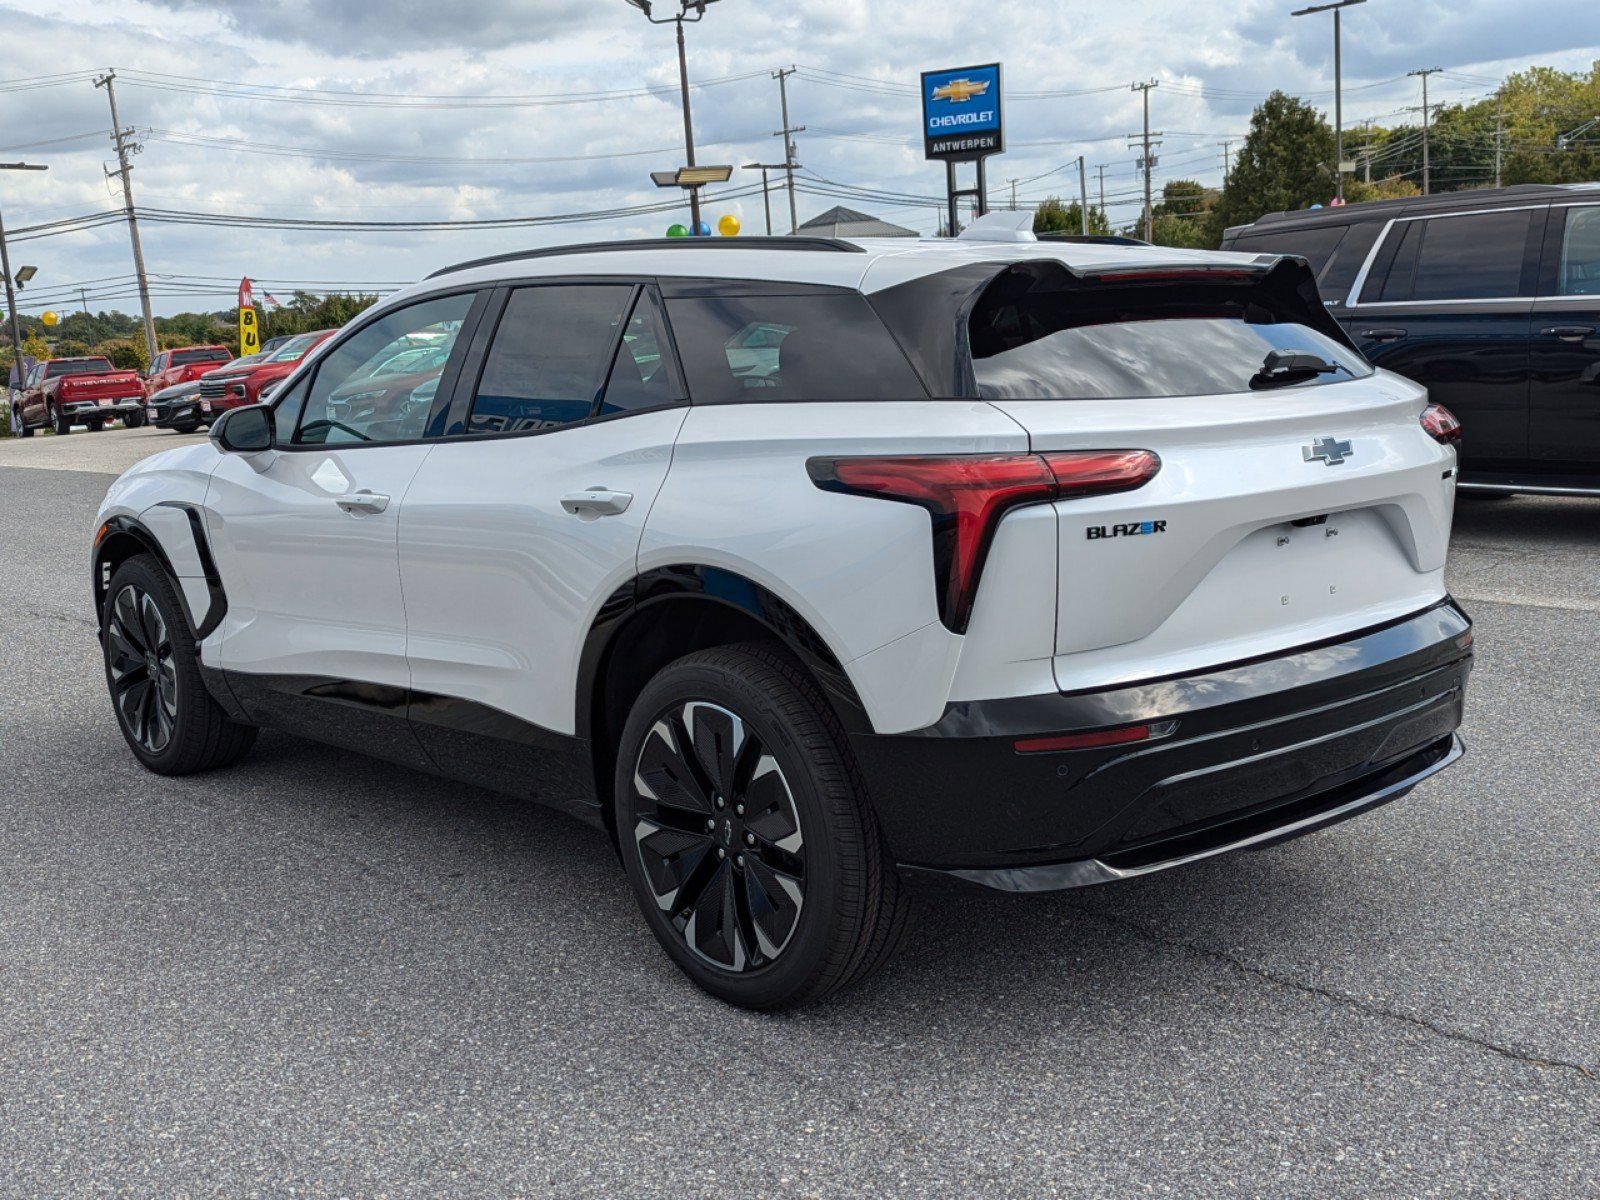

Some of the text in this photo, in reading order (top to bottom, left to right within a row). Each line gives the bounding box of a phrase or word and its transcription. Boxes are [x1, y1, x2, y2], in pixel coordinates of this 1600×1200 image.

[929, 111, 994, 128] CHEVROLET
[933, 137, 994, 153] ANTWERPEN
[73, 378, 131, 387] CHEVROLET
[1086, 519, 1167, 540] BLAZER
